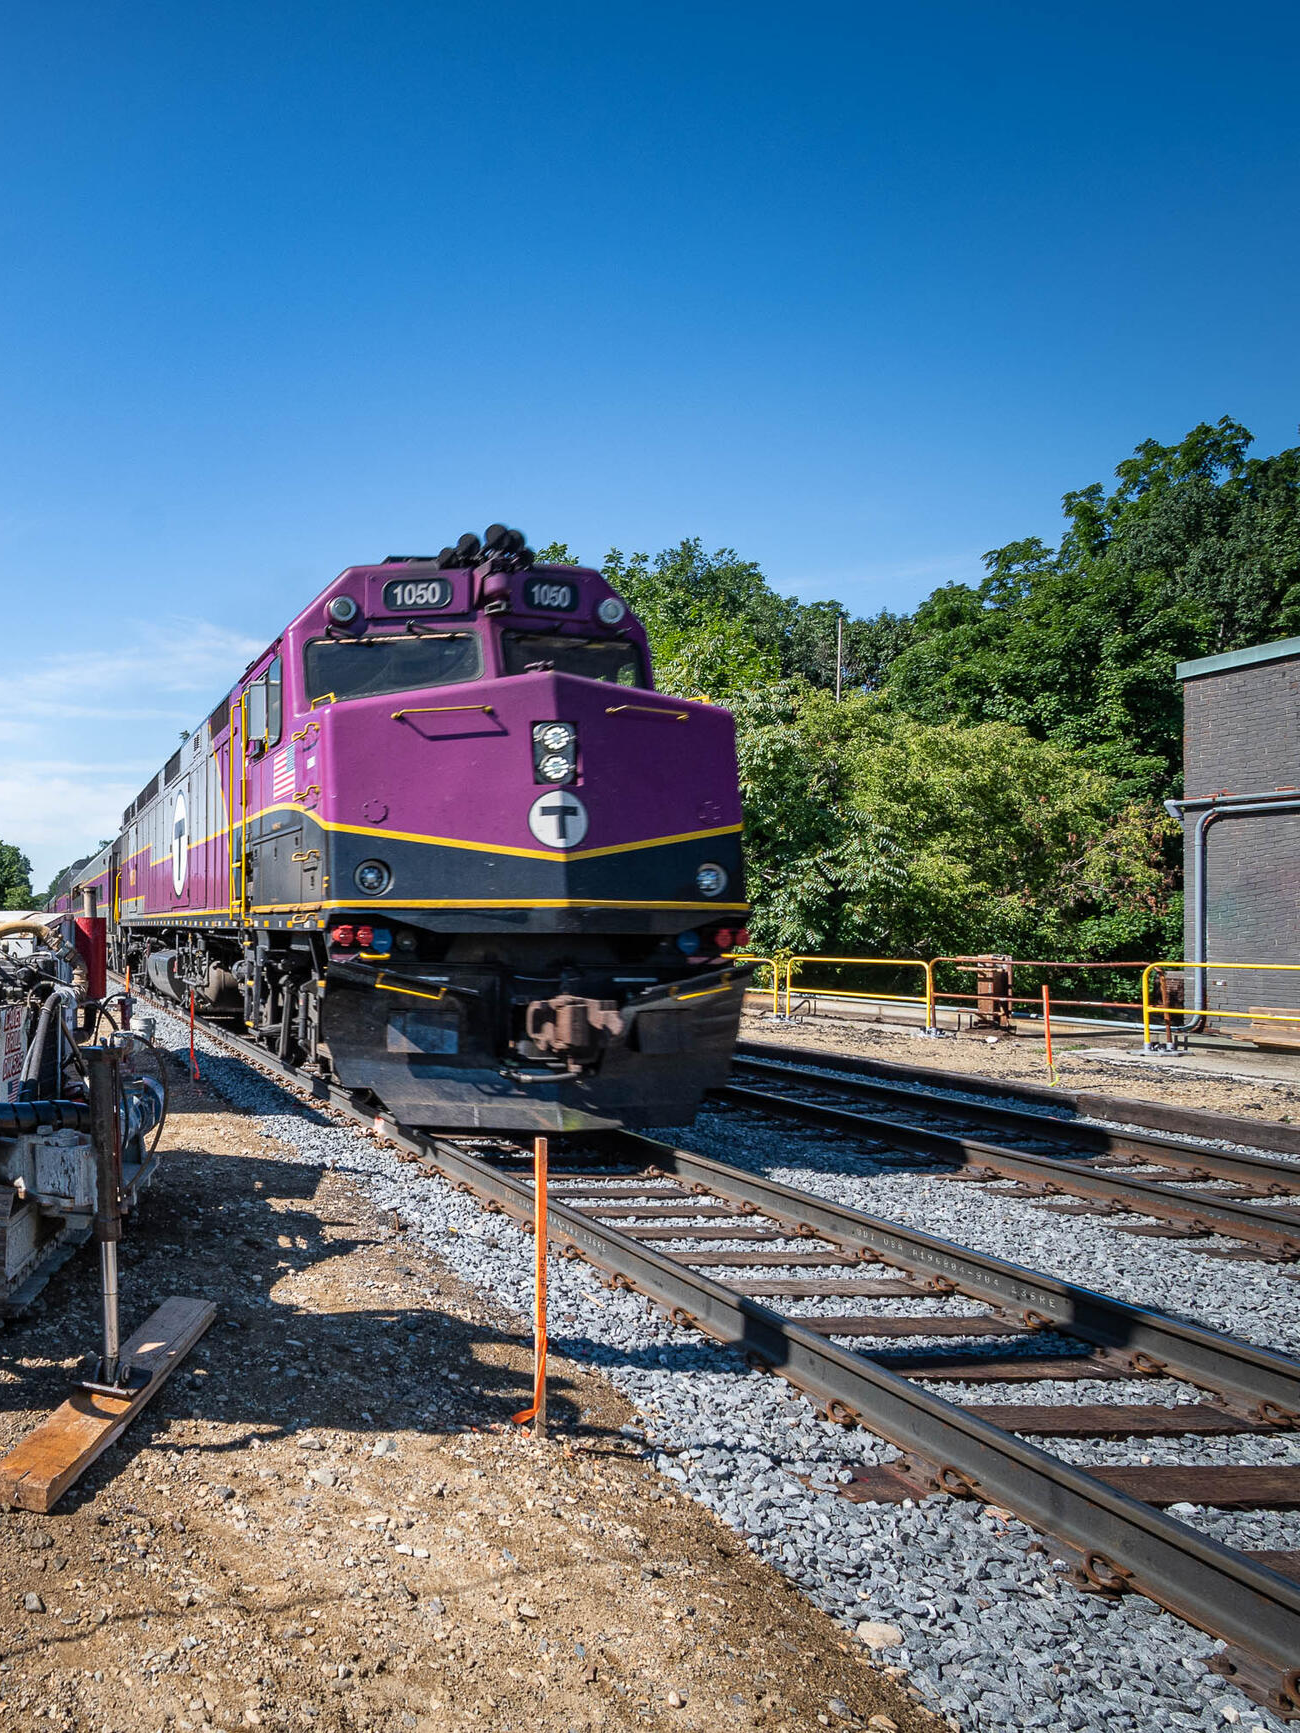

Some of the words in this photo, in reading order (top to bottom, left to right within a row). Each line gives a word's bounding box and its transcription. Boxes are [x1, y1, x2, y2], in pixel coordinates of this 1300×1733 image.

[393, 582, 441, 606] 1050
[532, 584, 571, 608] 1050
[541, 806, 578, 839] T
[174, 818, 186, 880] T
